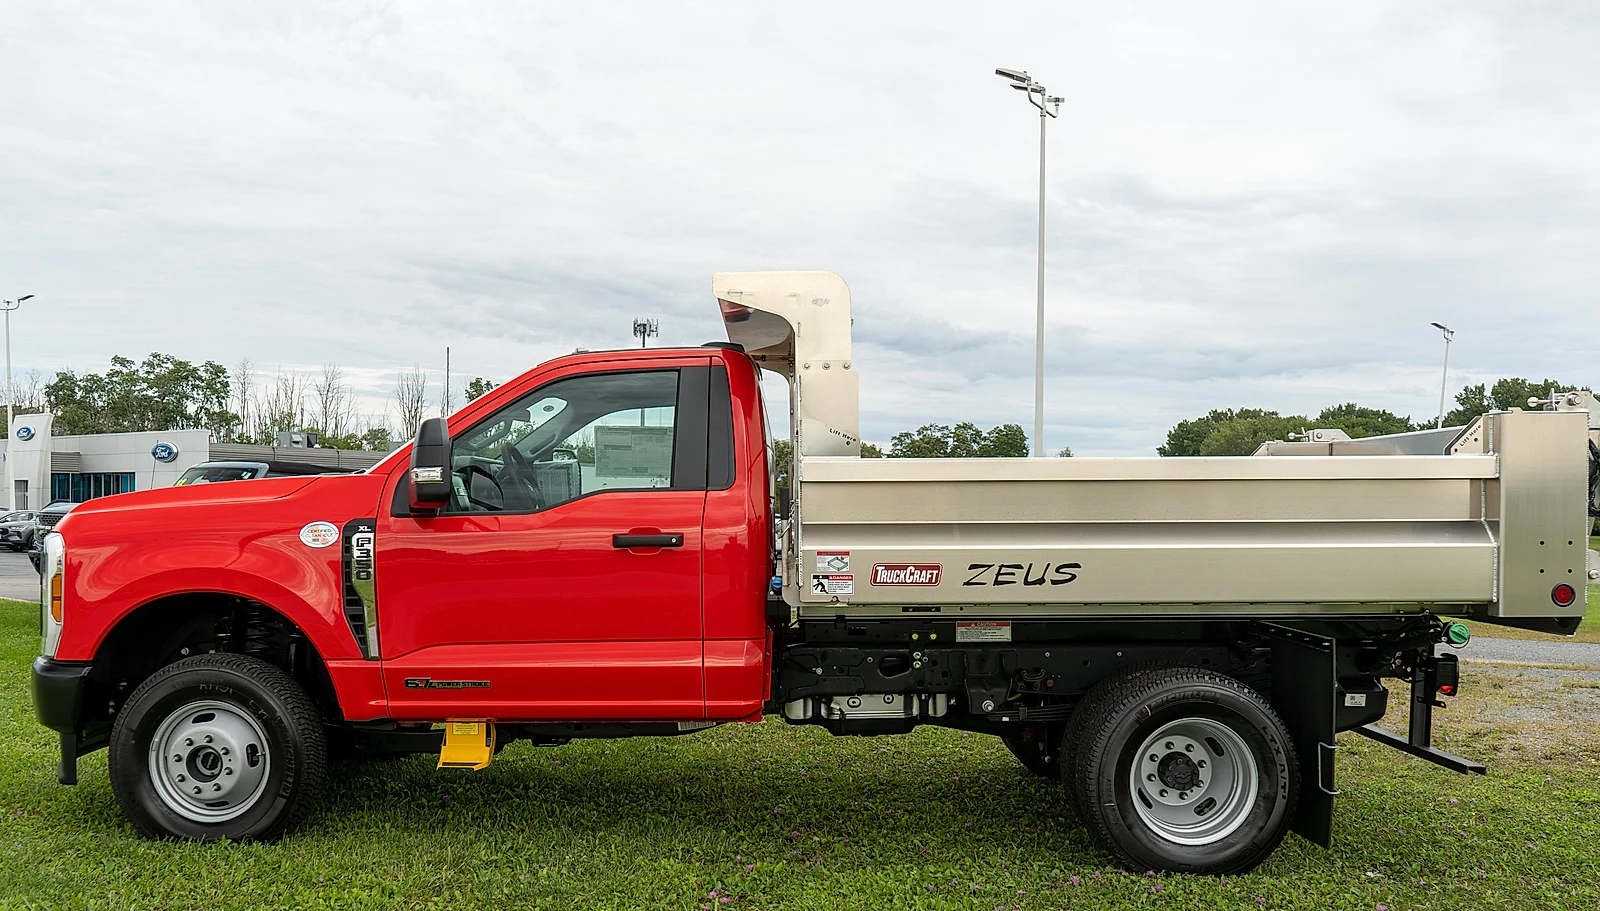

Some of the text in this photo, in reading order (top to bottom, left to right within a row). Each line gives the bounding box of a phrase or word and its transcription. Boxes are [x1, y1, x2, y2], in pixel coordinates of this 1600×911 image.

[829, 428, 857, 442] Lift Here
[1460, 424, 1482, 446] Lift Here
[155, 446, 170, 458] Ford
[962, 562, 1082, 587] ZEUS
